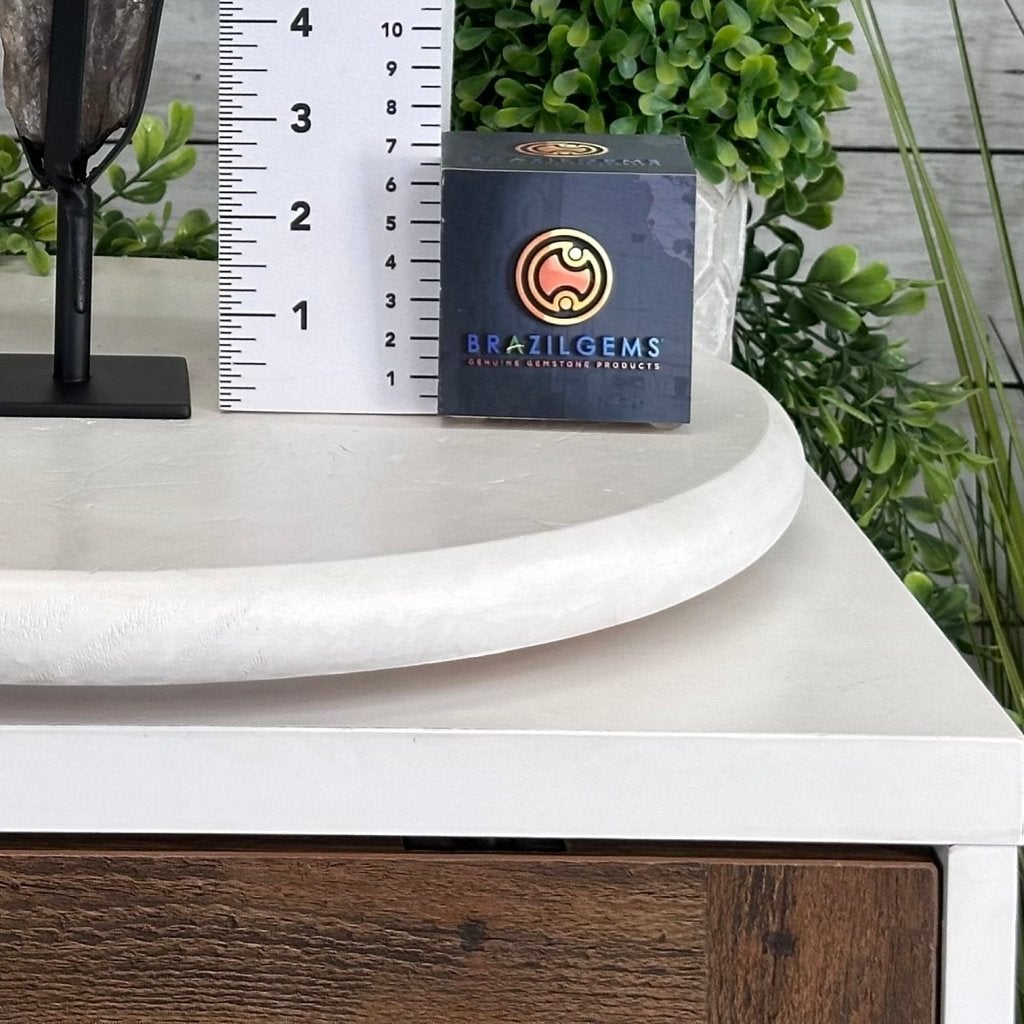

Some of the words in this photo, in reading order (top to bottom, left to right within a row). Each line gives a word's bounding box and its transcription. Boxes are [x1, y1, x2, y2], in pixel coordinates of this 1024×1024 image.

[290, 7, 313, 38] 4
[381, 21, 403, 38] 10
[386, 60, 398, 77] 9
[386, 99, 397, 115] 8
[290, 102, 312, 134] 3
[385, 138, 397, 154] 7
[385, 176, 397, 193] 6
[290, 200, 311, 232] 2
[385, 215, 397, 232] 5
[384, 254, 397, 270] 4
[385, 292, 397, 309] 3
[292, 300, 308, 331] 1
[384, 331, 397, 348] 2
[467, 358, 520, 367] GENUINE
[526, 359, 590, 369] GEMSTONE
[596, 361, 661, 370] PRODUCTS
[386, 370, 395, 387] 1
